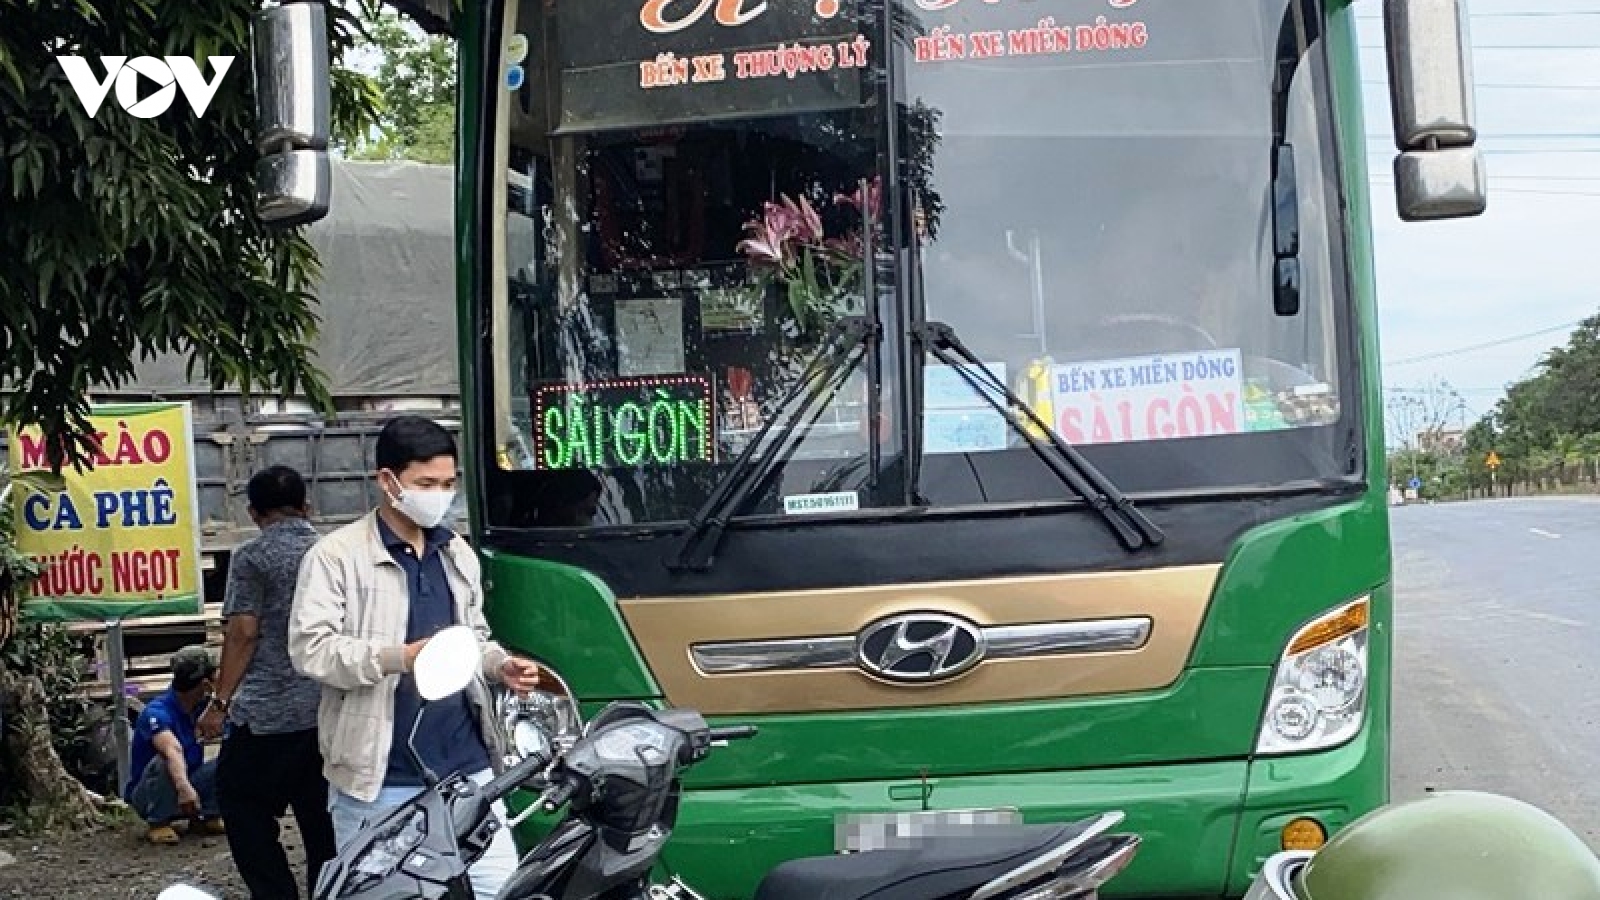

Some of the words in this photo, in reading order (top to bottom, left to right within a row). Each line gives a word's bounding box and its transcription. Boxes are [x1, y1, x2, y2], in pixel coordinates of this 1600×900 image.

[640, 52, 689, 88] BẾN
[692, 54, 726, 82] XE
[734, 43, 834, 78] THƯỢNG
[838, 34, 870, 67] LÝ
[914, 24, 966, 62] BẾN
[970, 31, 1005, 58] XE
[1057, 366, 1096, 393] BẾN
[1100, 367, 1126, 389] XE
[545, 393, 602, 468] SÀI
[613, 387, 707, 465] GÒN
[1060, 391, 1132, 443] SÀI
[1145, 383, 1238, 436] GÒN
[94, 477, 177, 529] PHÊ
[111, 549, 181, 600] NGỌT
